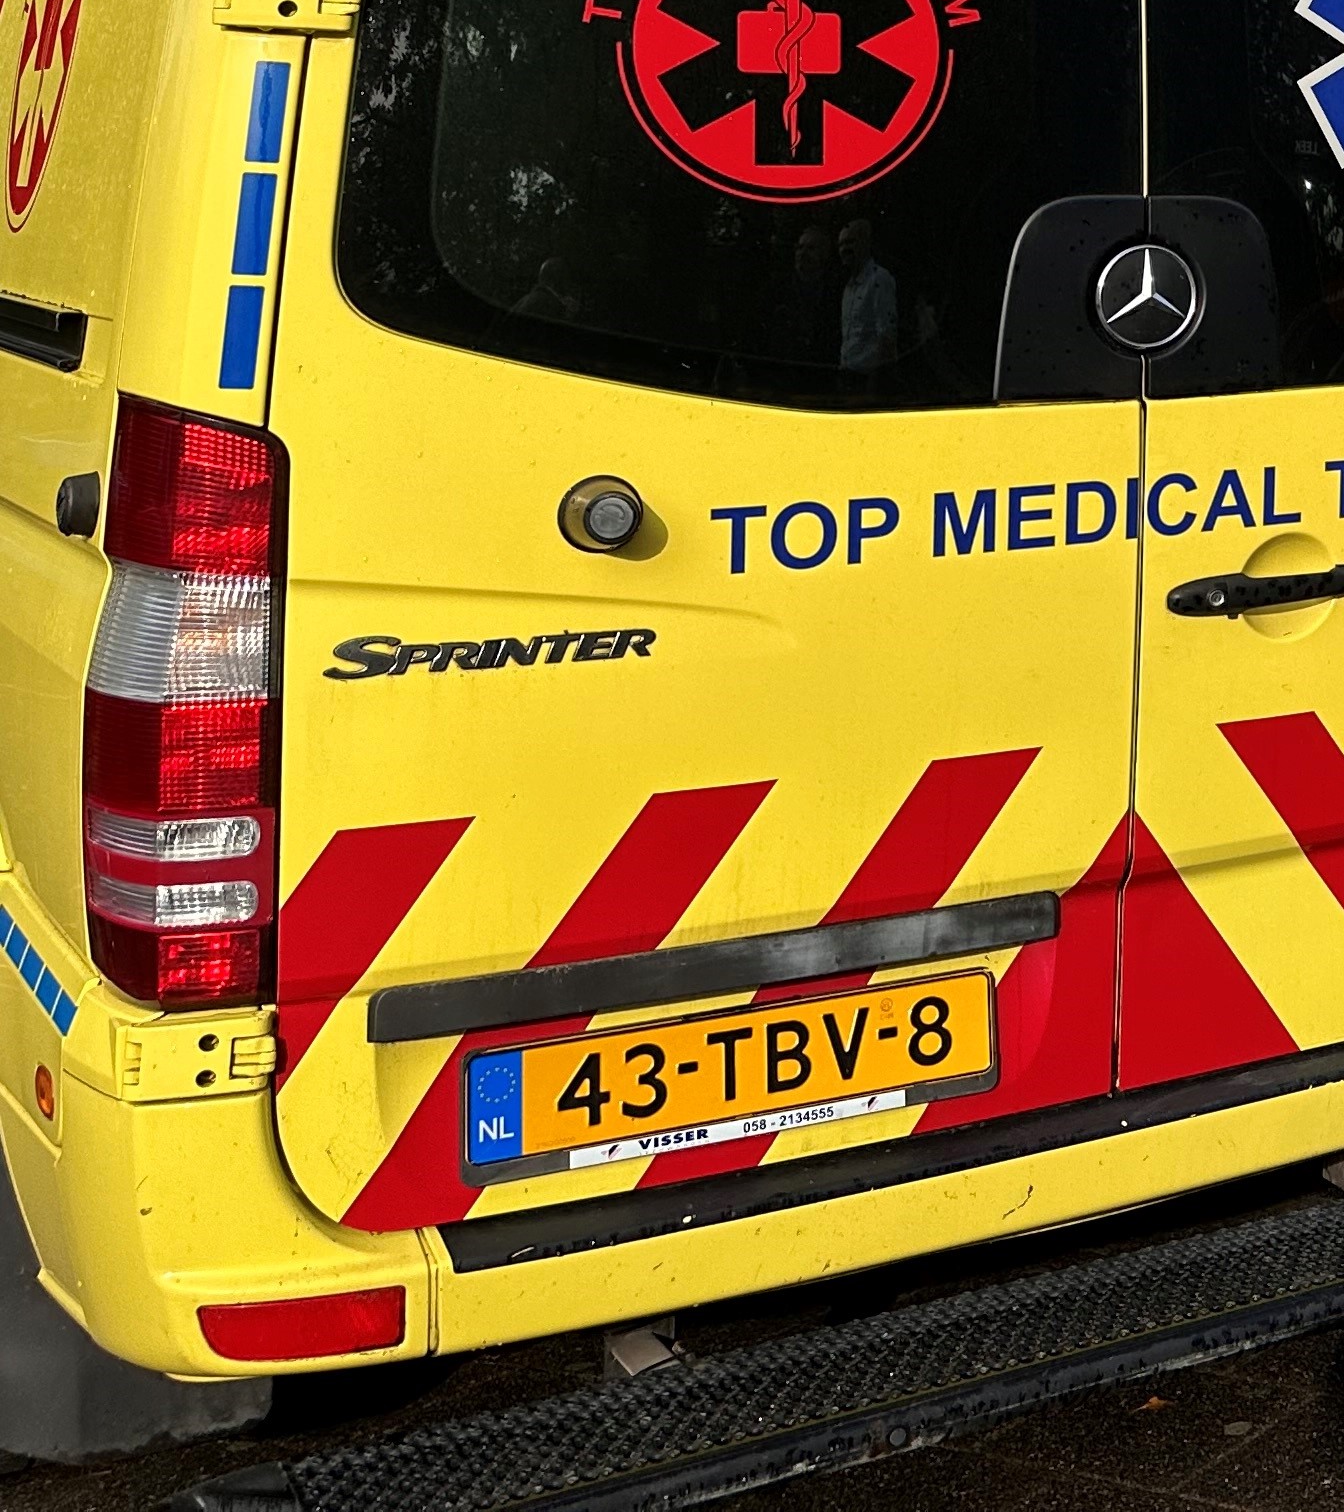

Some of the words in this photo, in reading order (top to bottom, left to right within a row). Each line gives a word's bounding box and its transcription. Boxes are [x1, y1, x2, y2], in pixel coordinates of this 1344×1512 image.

[710, 497, 900, 575] TOP
[933, 466, 1302, 557] MEDICAL
[555, 995, 953, 1127] 43-TBV-8
[478, 1116, 515, 1144] NL
[638, 1129, 709, 1150] VISSER
[743, 1119, 767, 1134] 058
[779, 1106, 834, 1127] 2134555
